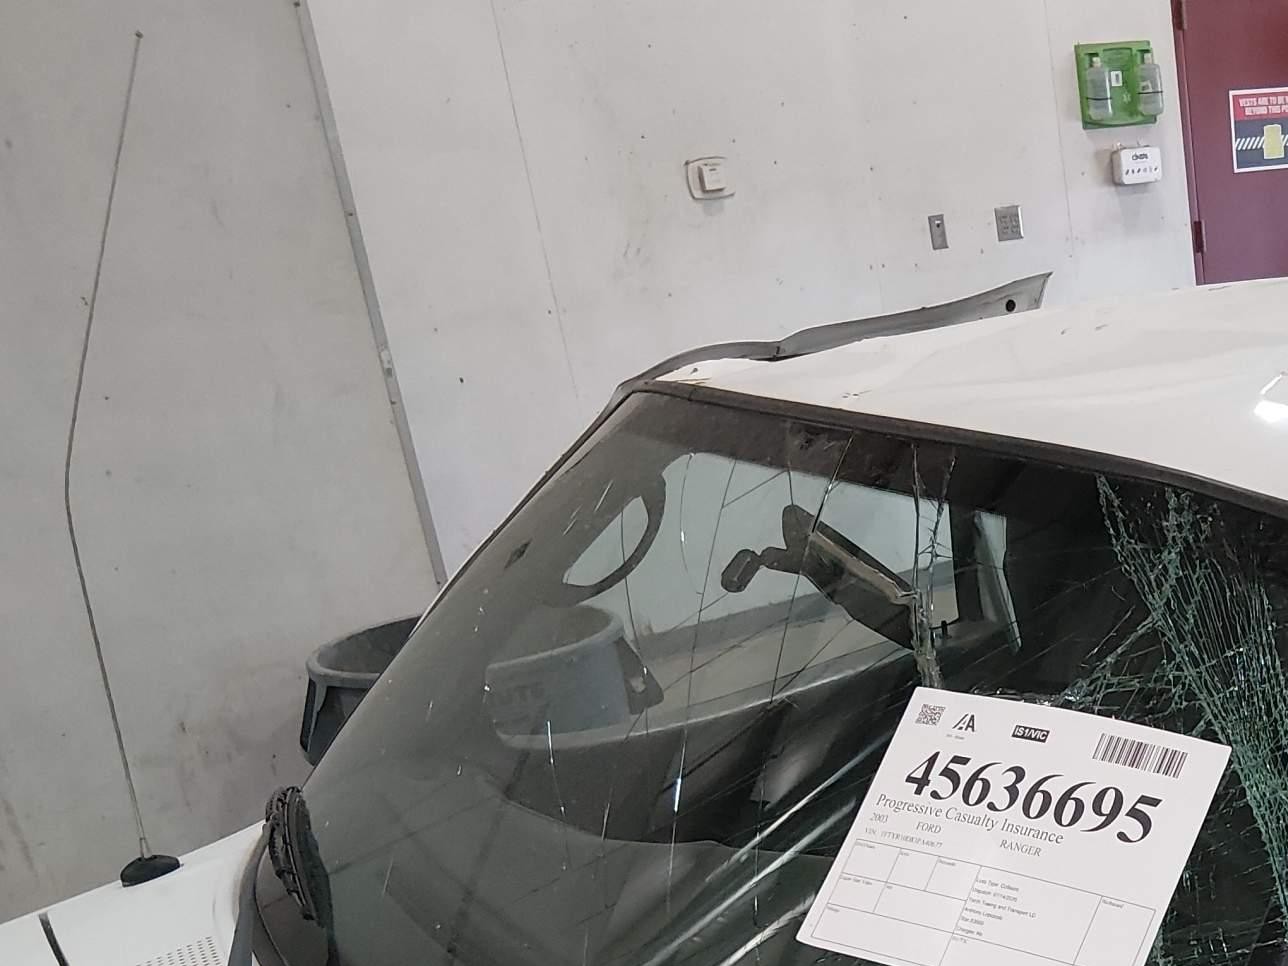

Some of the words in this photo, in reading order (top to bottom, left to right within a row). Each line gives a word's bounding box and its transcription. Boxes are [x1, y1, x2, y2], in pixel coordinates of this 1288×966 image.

[1239, 98, 1257, 107] VESTS
[1258, 96, 1269, 105] ARE
[1269, 96, 1277, 105] TO
[1014, 725, 1048, 740] IS1/VIC
[876, 793, 942, 817] Progressive
[945, 806, 999, 831] Casualty
[1001, 818, 1064, 844] Insurance
[905, 751, 1163, 843] 45636695
[870, 812, 889, 824] 2003
[916, 821, 942, 834] FORD
[1000, 839, 1042, 857] RANGER
